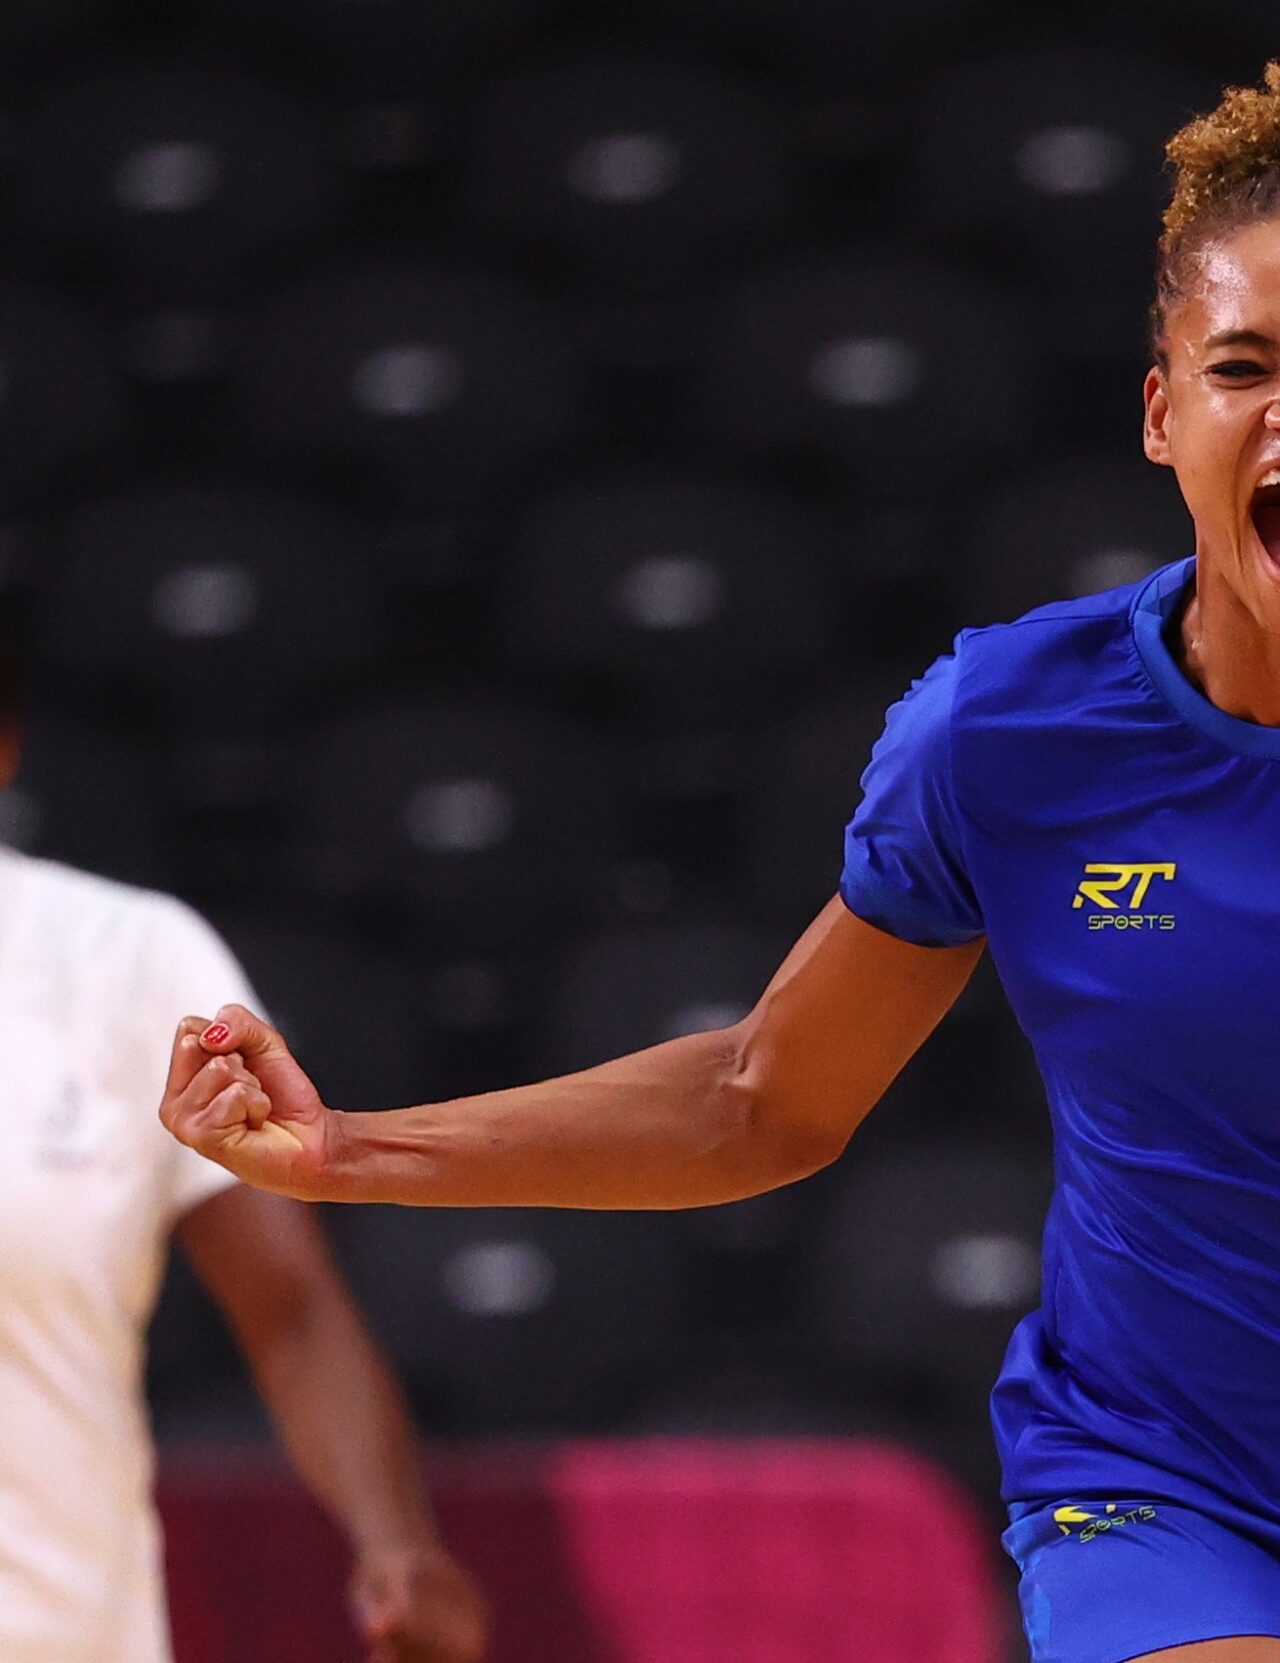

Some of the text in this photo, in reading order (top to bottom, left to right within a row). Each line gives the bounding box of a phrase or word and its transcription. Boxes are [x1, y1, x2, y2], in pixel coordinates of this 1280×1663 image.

[1072, 863, 1176, 909] RT
[1088, 915, 1175, 930] SPORTS
[1080, 1505, 1156, 1543] SPORTS
